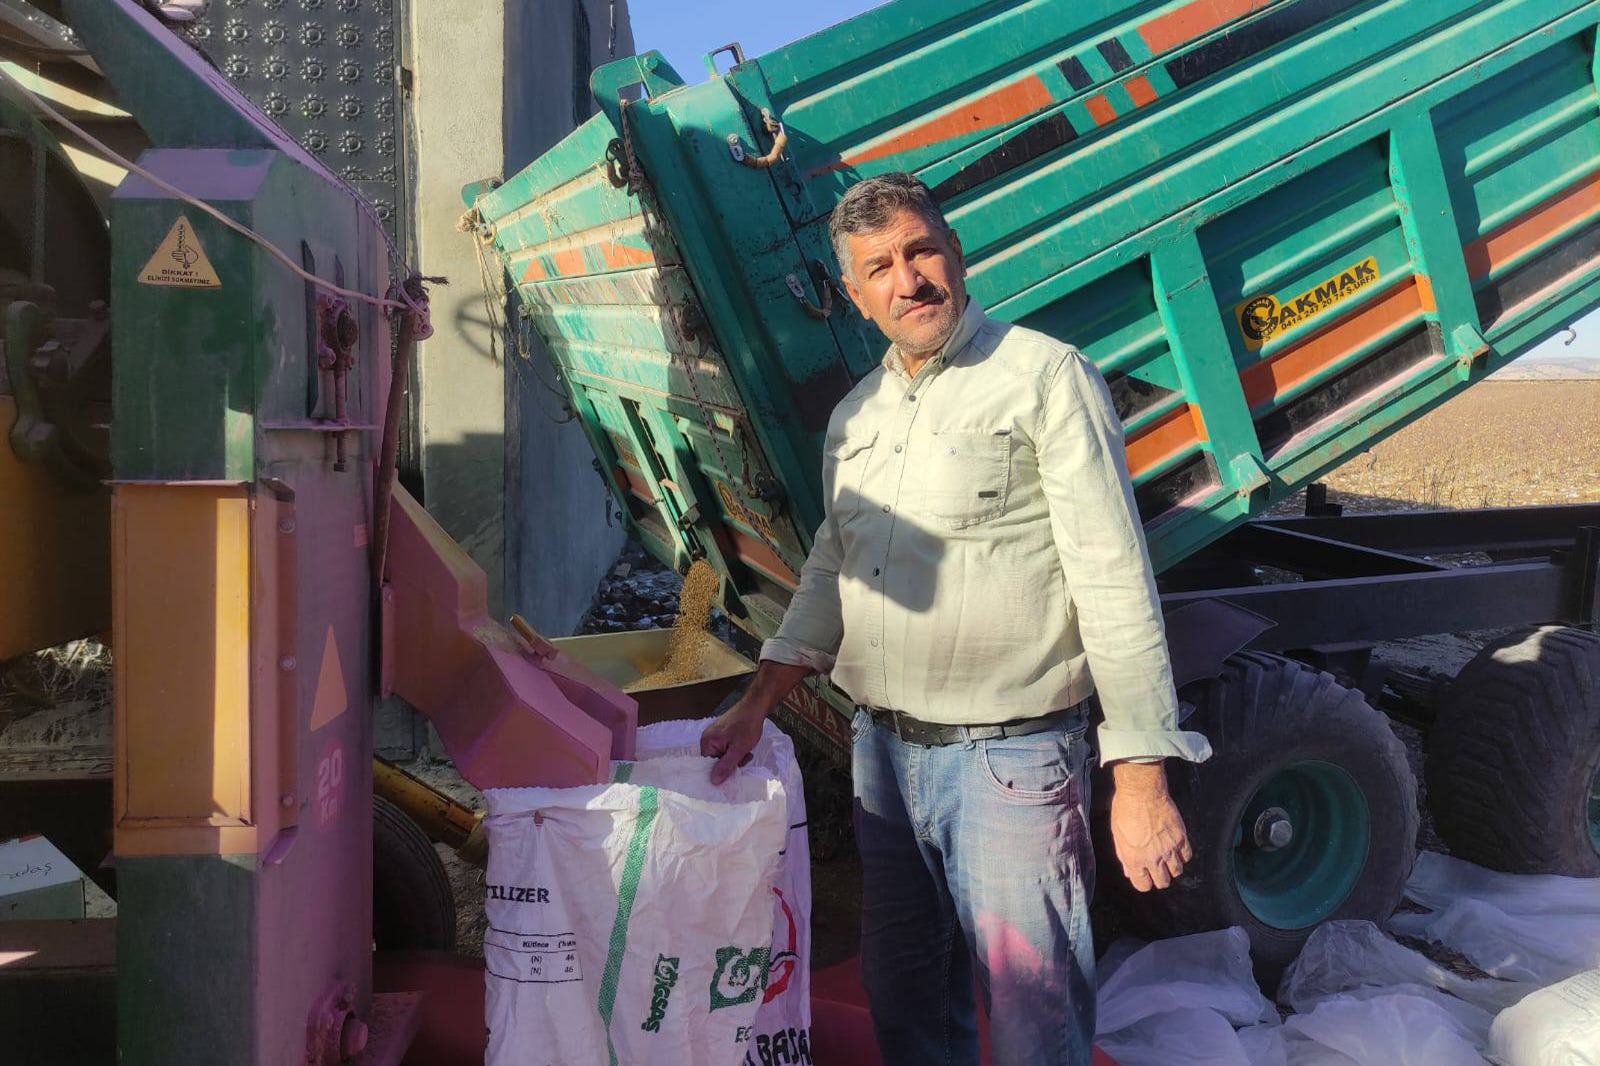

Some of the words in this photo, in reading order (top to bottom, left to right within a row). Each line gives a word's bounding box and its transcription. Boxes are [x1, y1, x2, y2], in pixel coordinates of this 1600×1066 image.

[1281, 313, 1302, 331] 0414
[1303, 304, 1319, 318] 247
[1321, 297, 1332, 308] 20
[1333, 291, 1345, 302] 74
[318, 747, 341, 799] 20
[530, 966, 541, 976] (N)
[531, 955, 542, 964] (N)
[565, 953, 575, 962] 46
